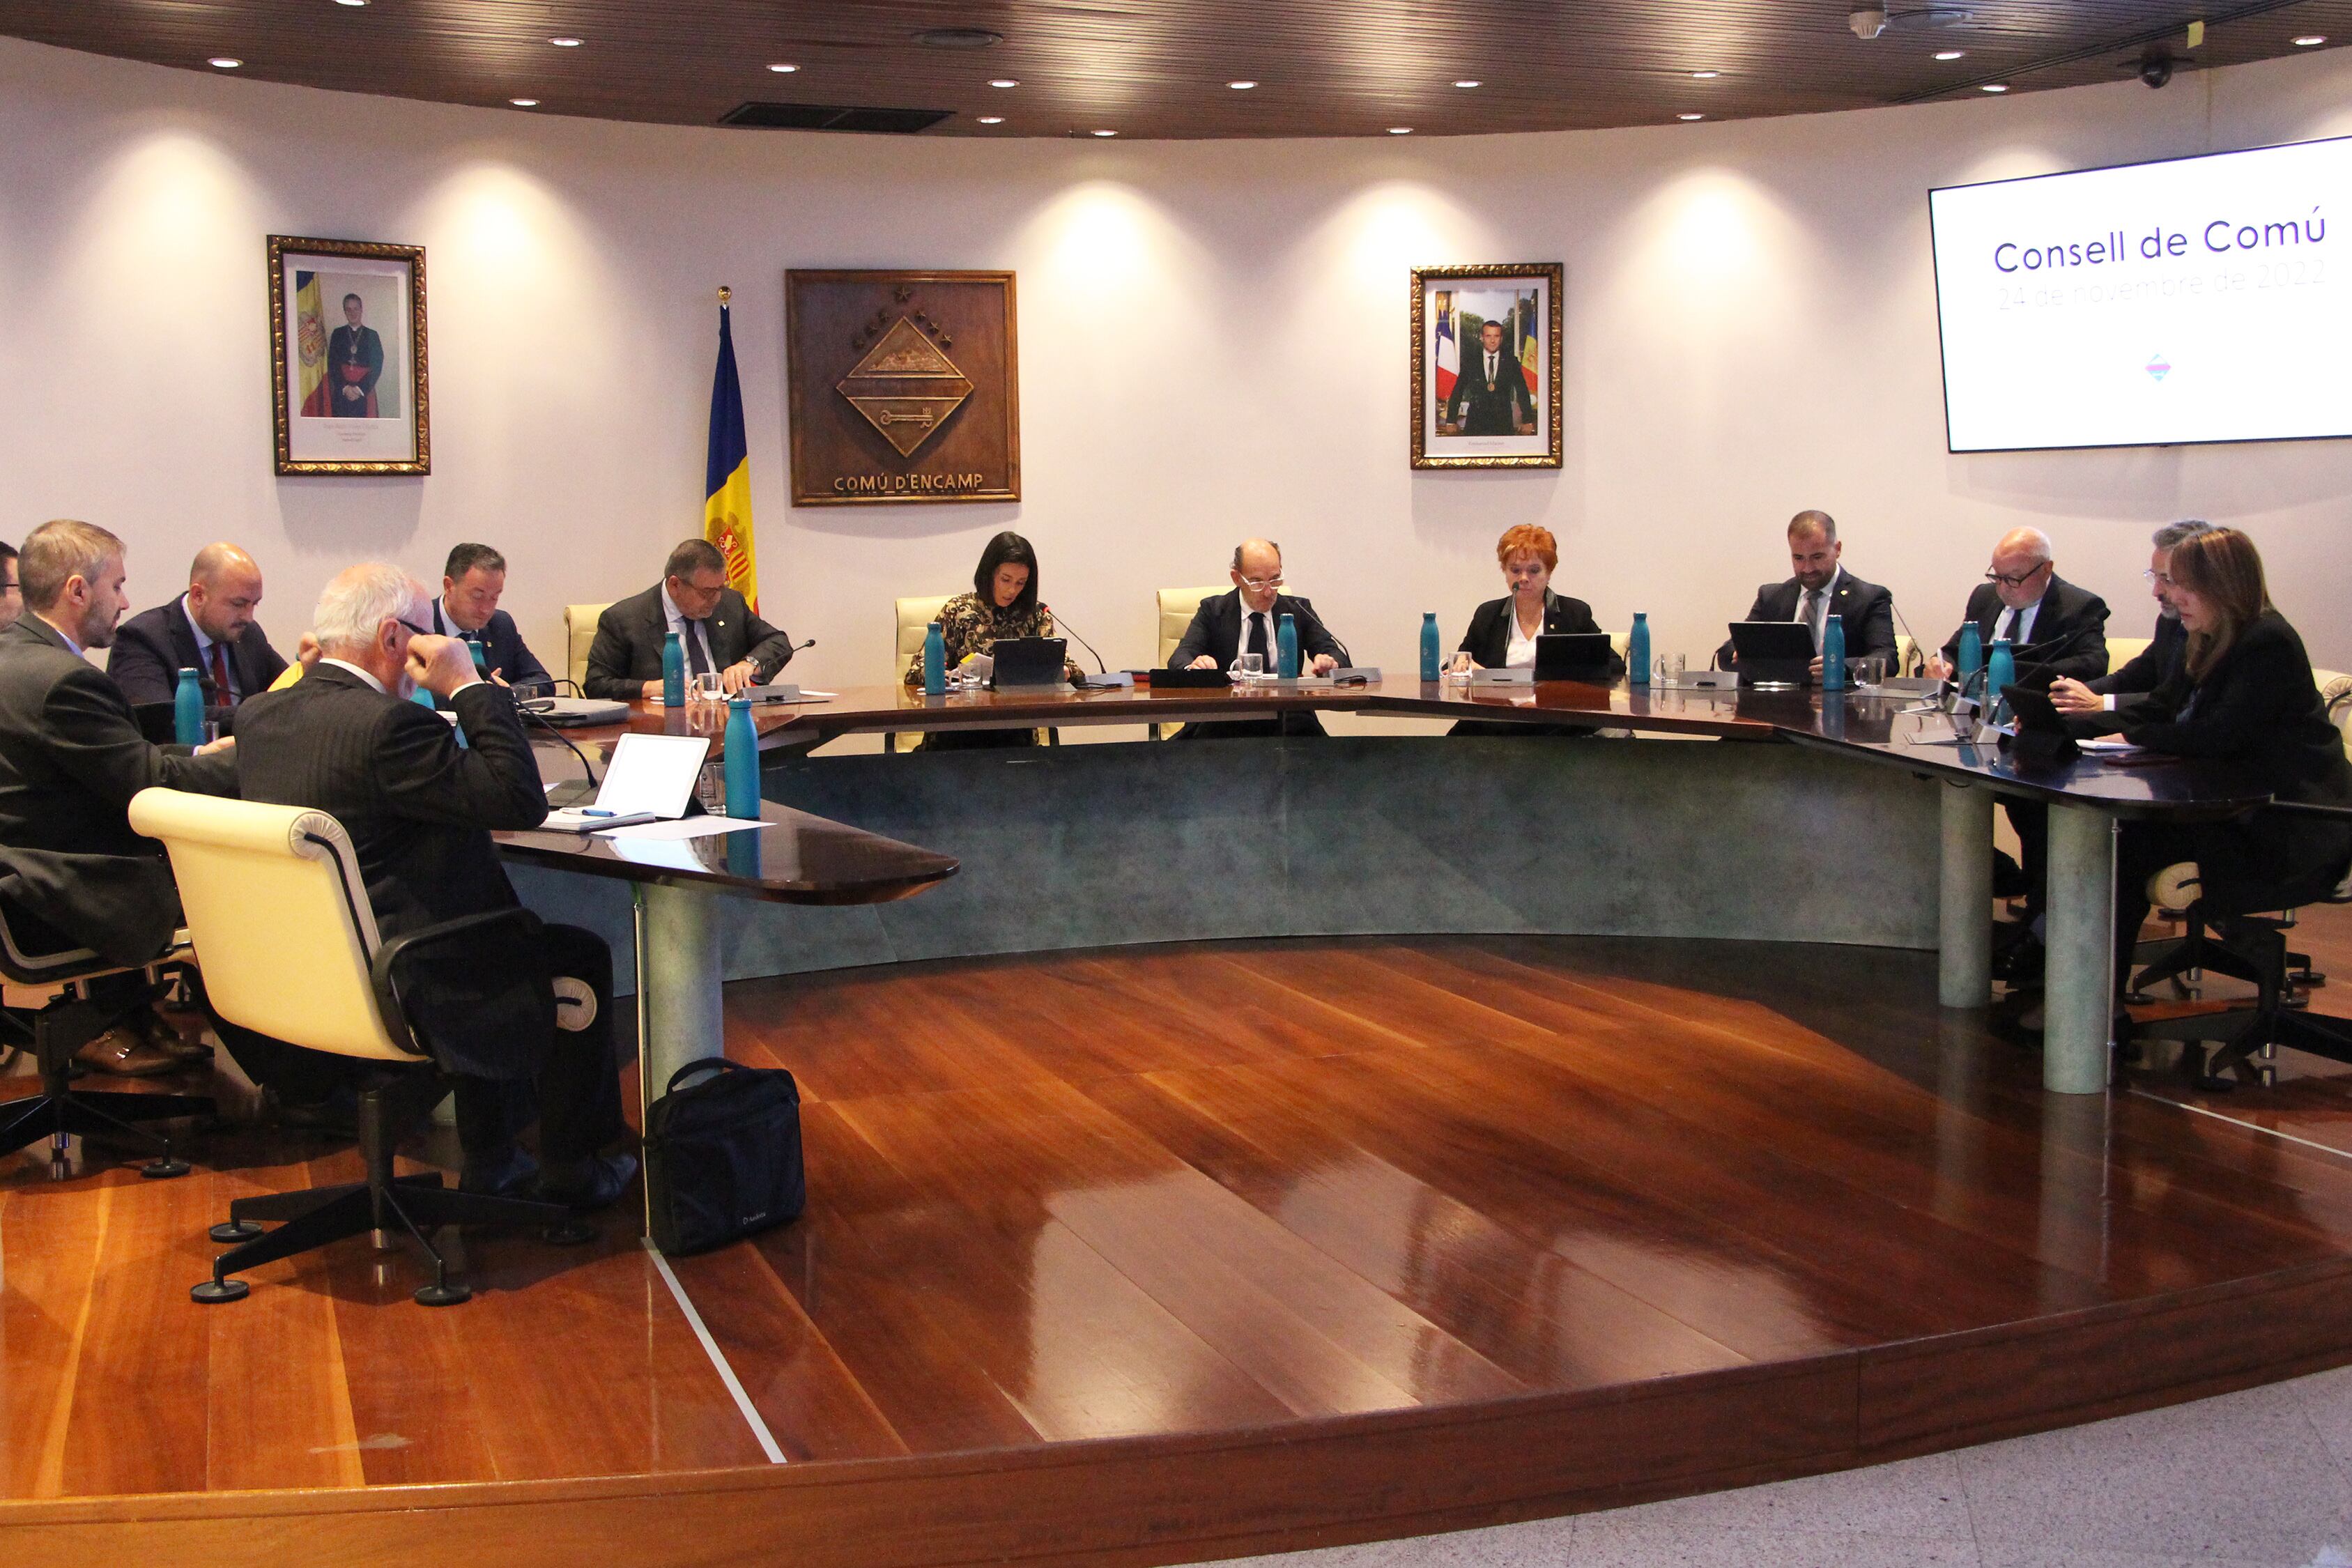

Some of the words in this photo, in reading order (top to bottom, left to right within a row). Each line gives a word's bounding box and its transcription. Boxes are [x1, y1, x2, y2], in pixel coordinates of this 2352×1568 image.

[1994, 231, 2125, 273] Consell
[2140, 226, 2188, 259] de
[2204, 206, 2326, 253] Comú
[1999, 286, 2027, 311] 24
[2034, 284, 2063, 307] de
[2074, 275, 2203, 305] novembre
[2214, 268, 2245, 293] de
[2257, 259, 2326, 289] 2022
[833, 472, 889, 491] COMÚ
[895, 473, 983, 490] D'ENCAMP
